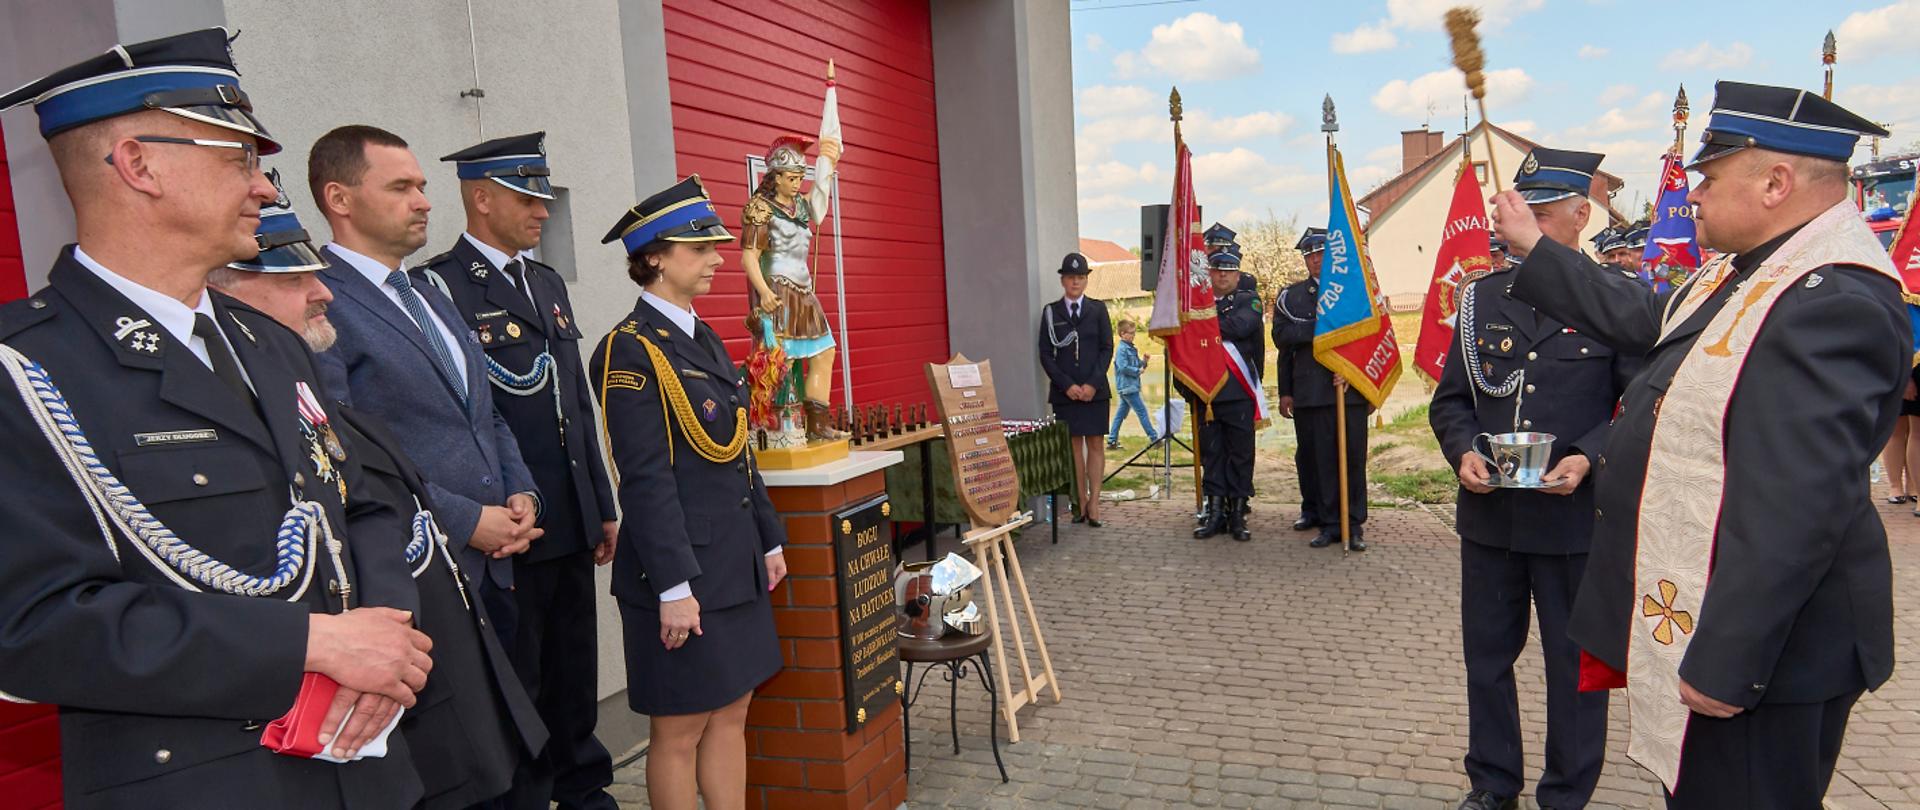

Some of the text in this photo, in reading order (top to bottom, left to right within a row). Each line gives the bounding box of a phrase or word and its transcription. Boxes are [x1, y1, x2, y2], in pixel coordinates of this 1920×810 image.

[857, 525, 878, 548] BOGU
[847, 558, 860, 578] NA
[854, 568, 888, 599] LUDZIOM
[849, 587, 895, 627] NA RATUNEK
